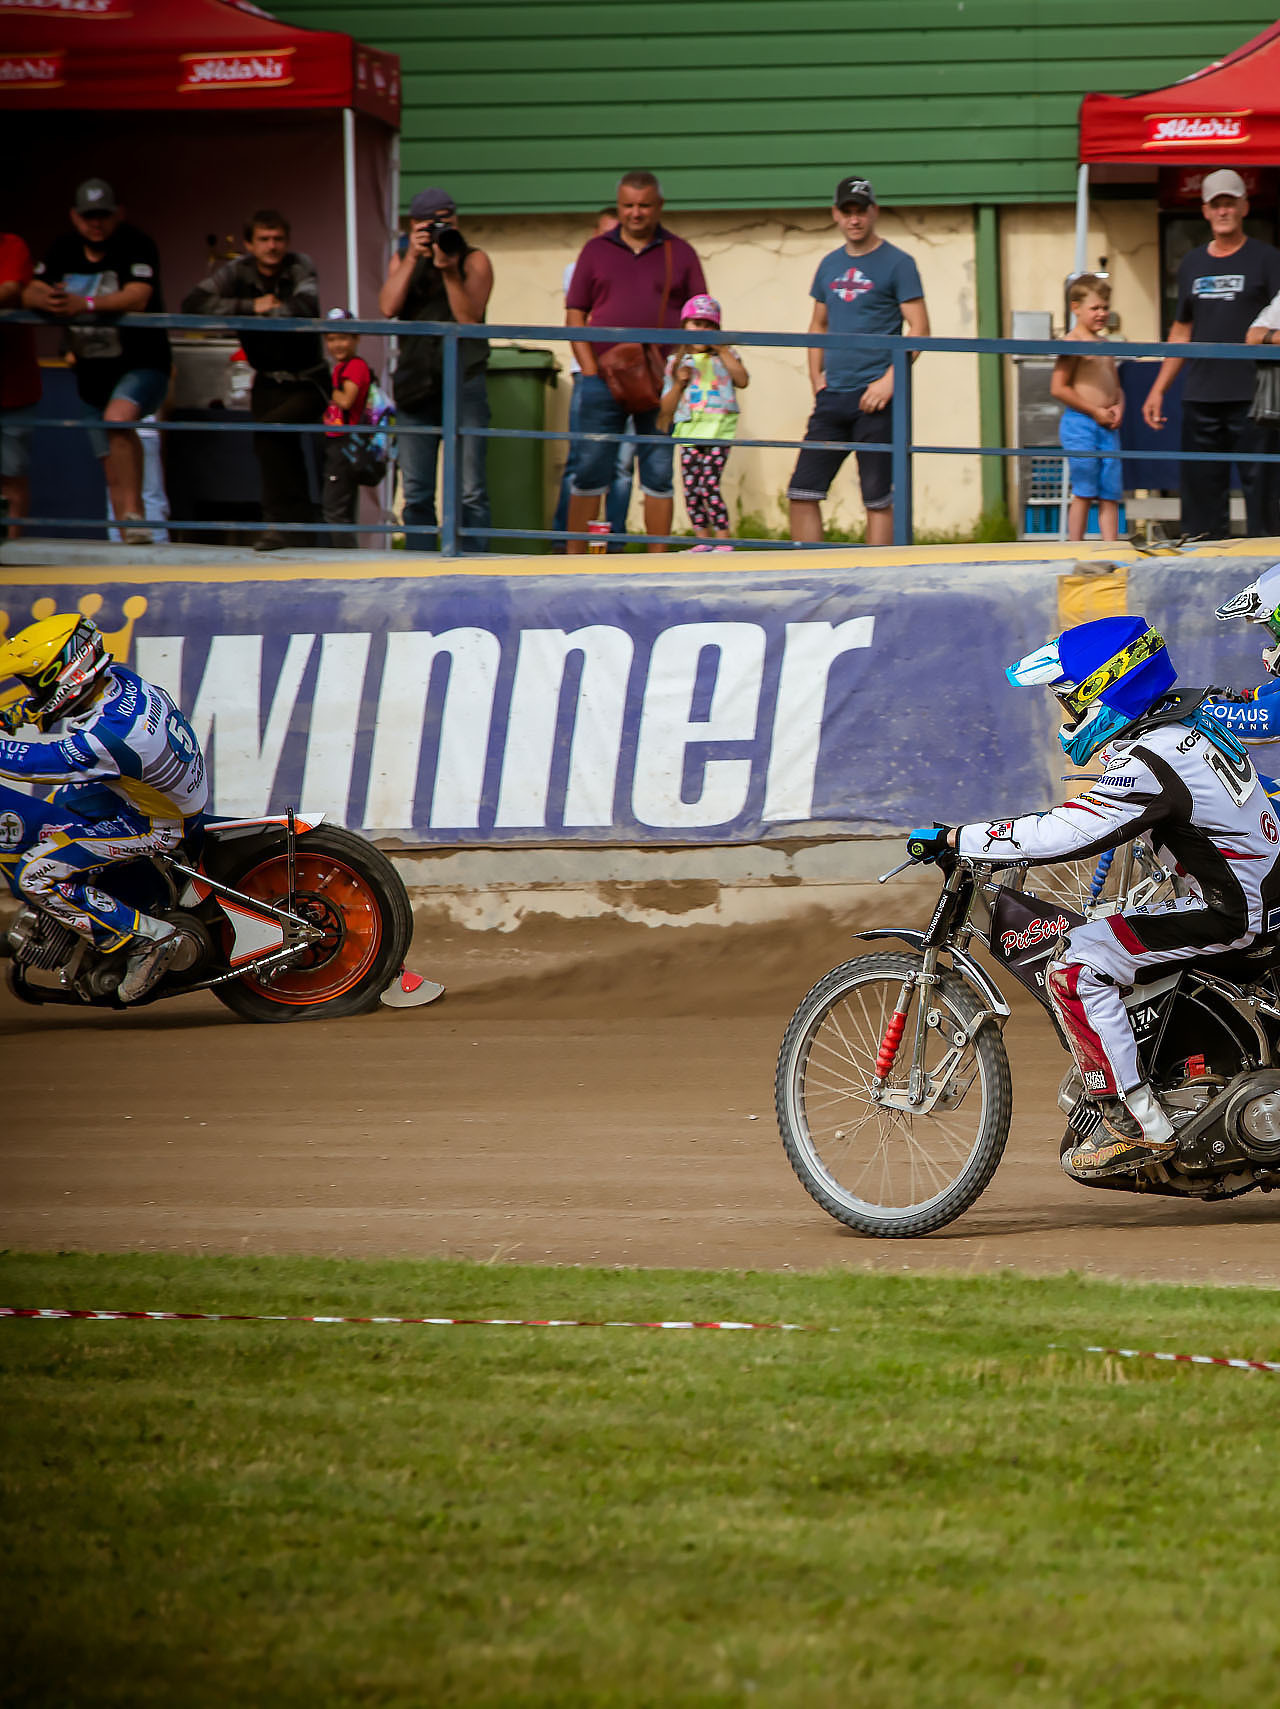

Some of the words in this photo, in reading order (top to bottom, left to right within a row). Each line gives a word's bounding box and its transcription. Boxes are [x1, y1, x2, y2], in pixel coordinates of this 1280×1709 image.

[189, 57, 283, 83] Aldaris
[1153, 118, 1241, 140] Aldaris
[0, 616, 875, 828] winner
[168, 715, 194, 755] 5
[1226, 721, 1269, 731] BANK
